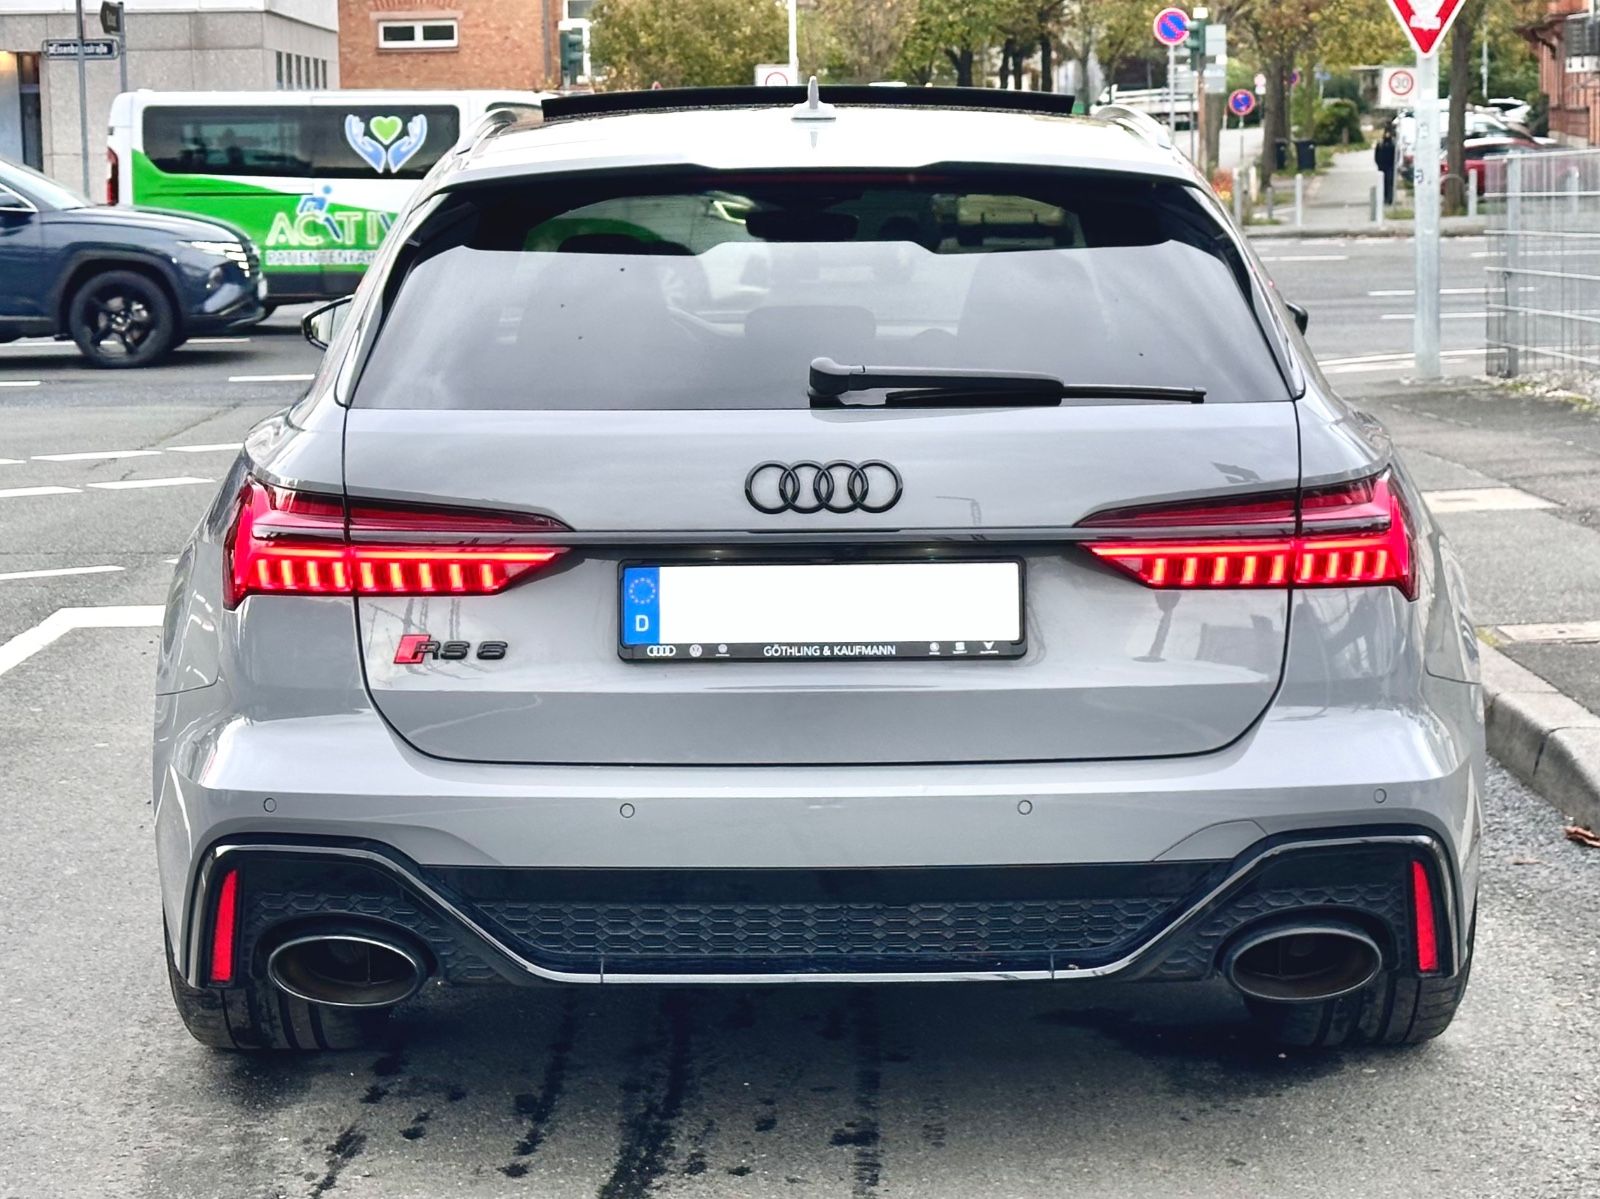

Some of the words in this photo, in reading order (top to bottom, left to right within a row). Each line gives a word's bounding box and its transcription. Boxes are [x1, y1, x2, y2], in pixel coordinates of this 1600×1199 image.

[1394, 76, 1409, 89] 30
[635, 614, 649, 632] D
[763, 644, 820, 657] GÖTHLING
[822, 645, 831, 656] &
[833, 645, 896, 656] KAUFMANN
